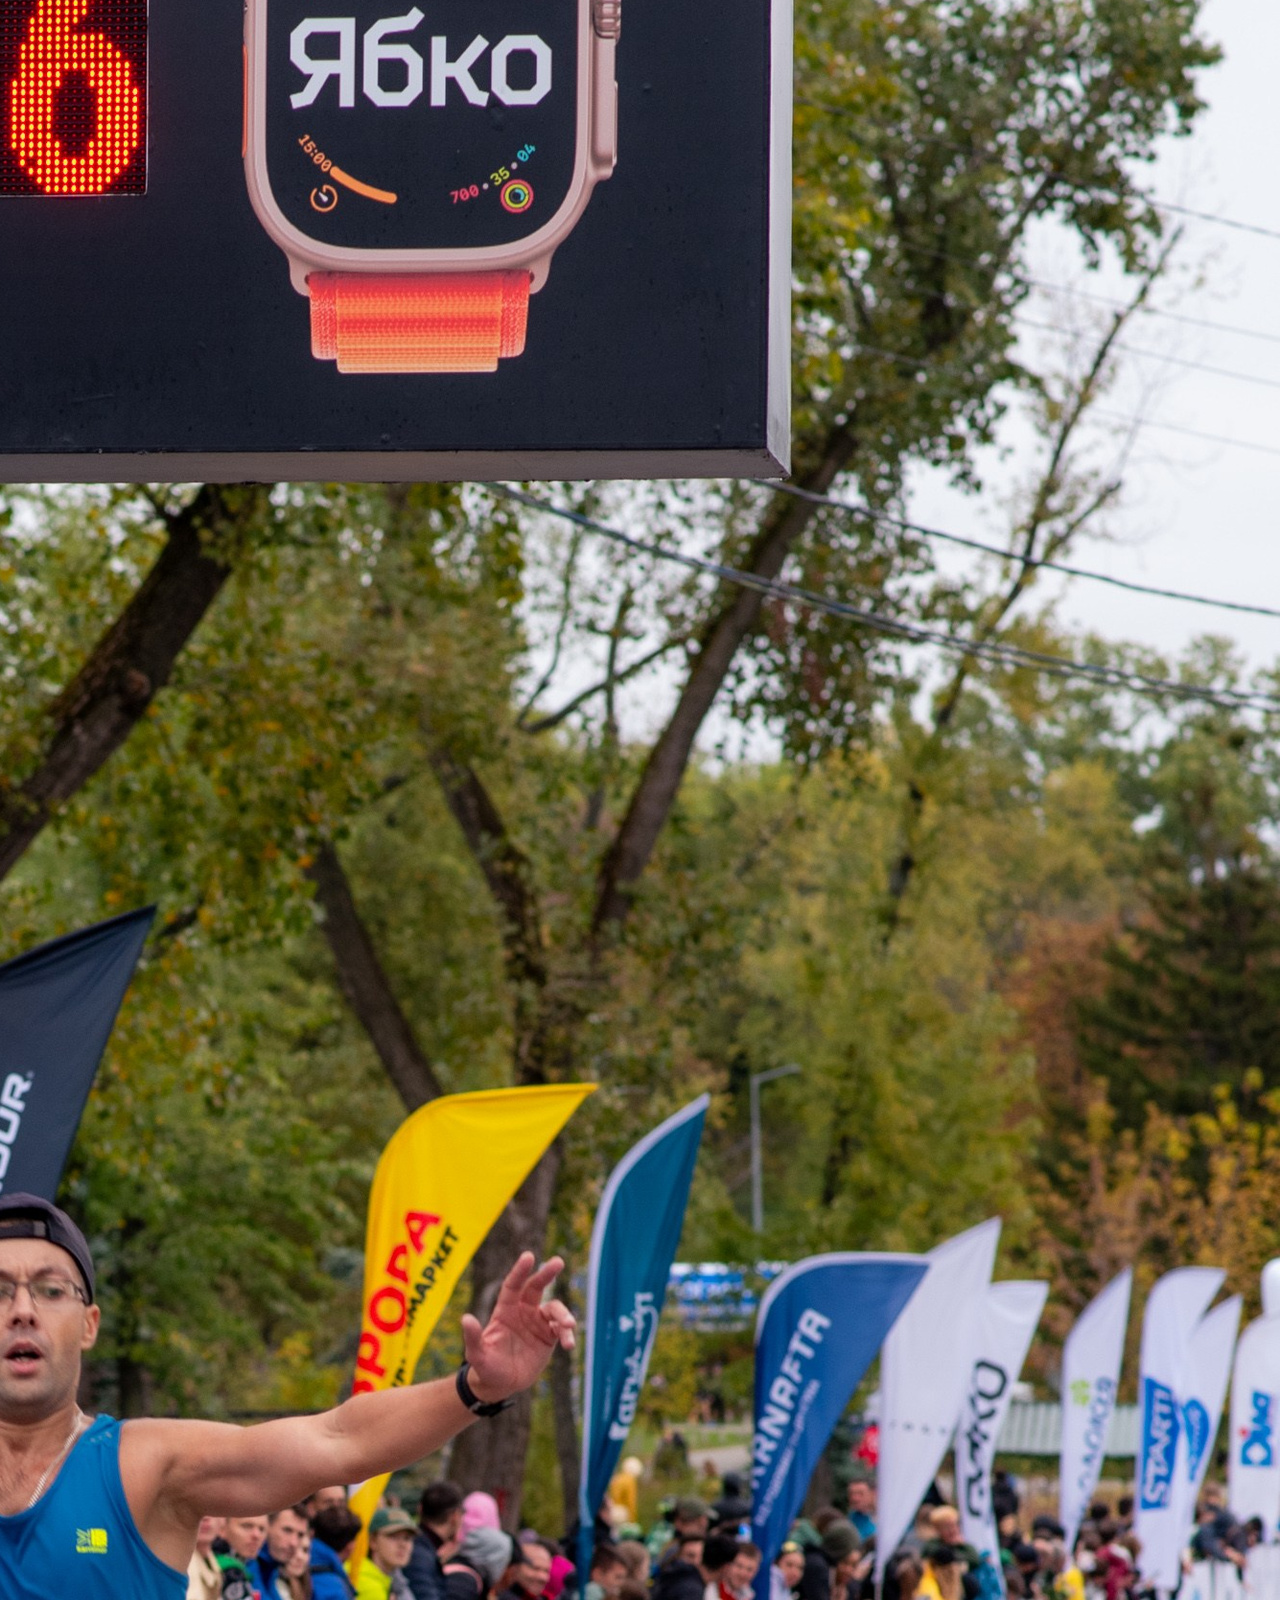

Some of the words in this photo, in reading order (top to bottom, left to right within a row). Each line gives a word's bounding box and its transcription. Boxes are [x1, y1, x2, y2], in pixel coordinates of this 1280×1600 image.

[289, 6, 553, 109] Ябко
[297, 133, 333, 173] 15:00
[450, 184, 480, 204] 700
[489, 166, 511, 186] 35
[516, 142, 536, 163] 04
[352, 1211, 441, 1394] РОРА
